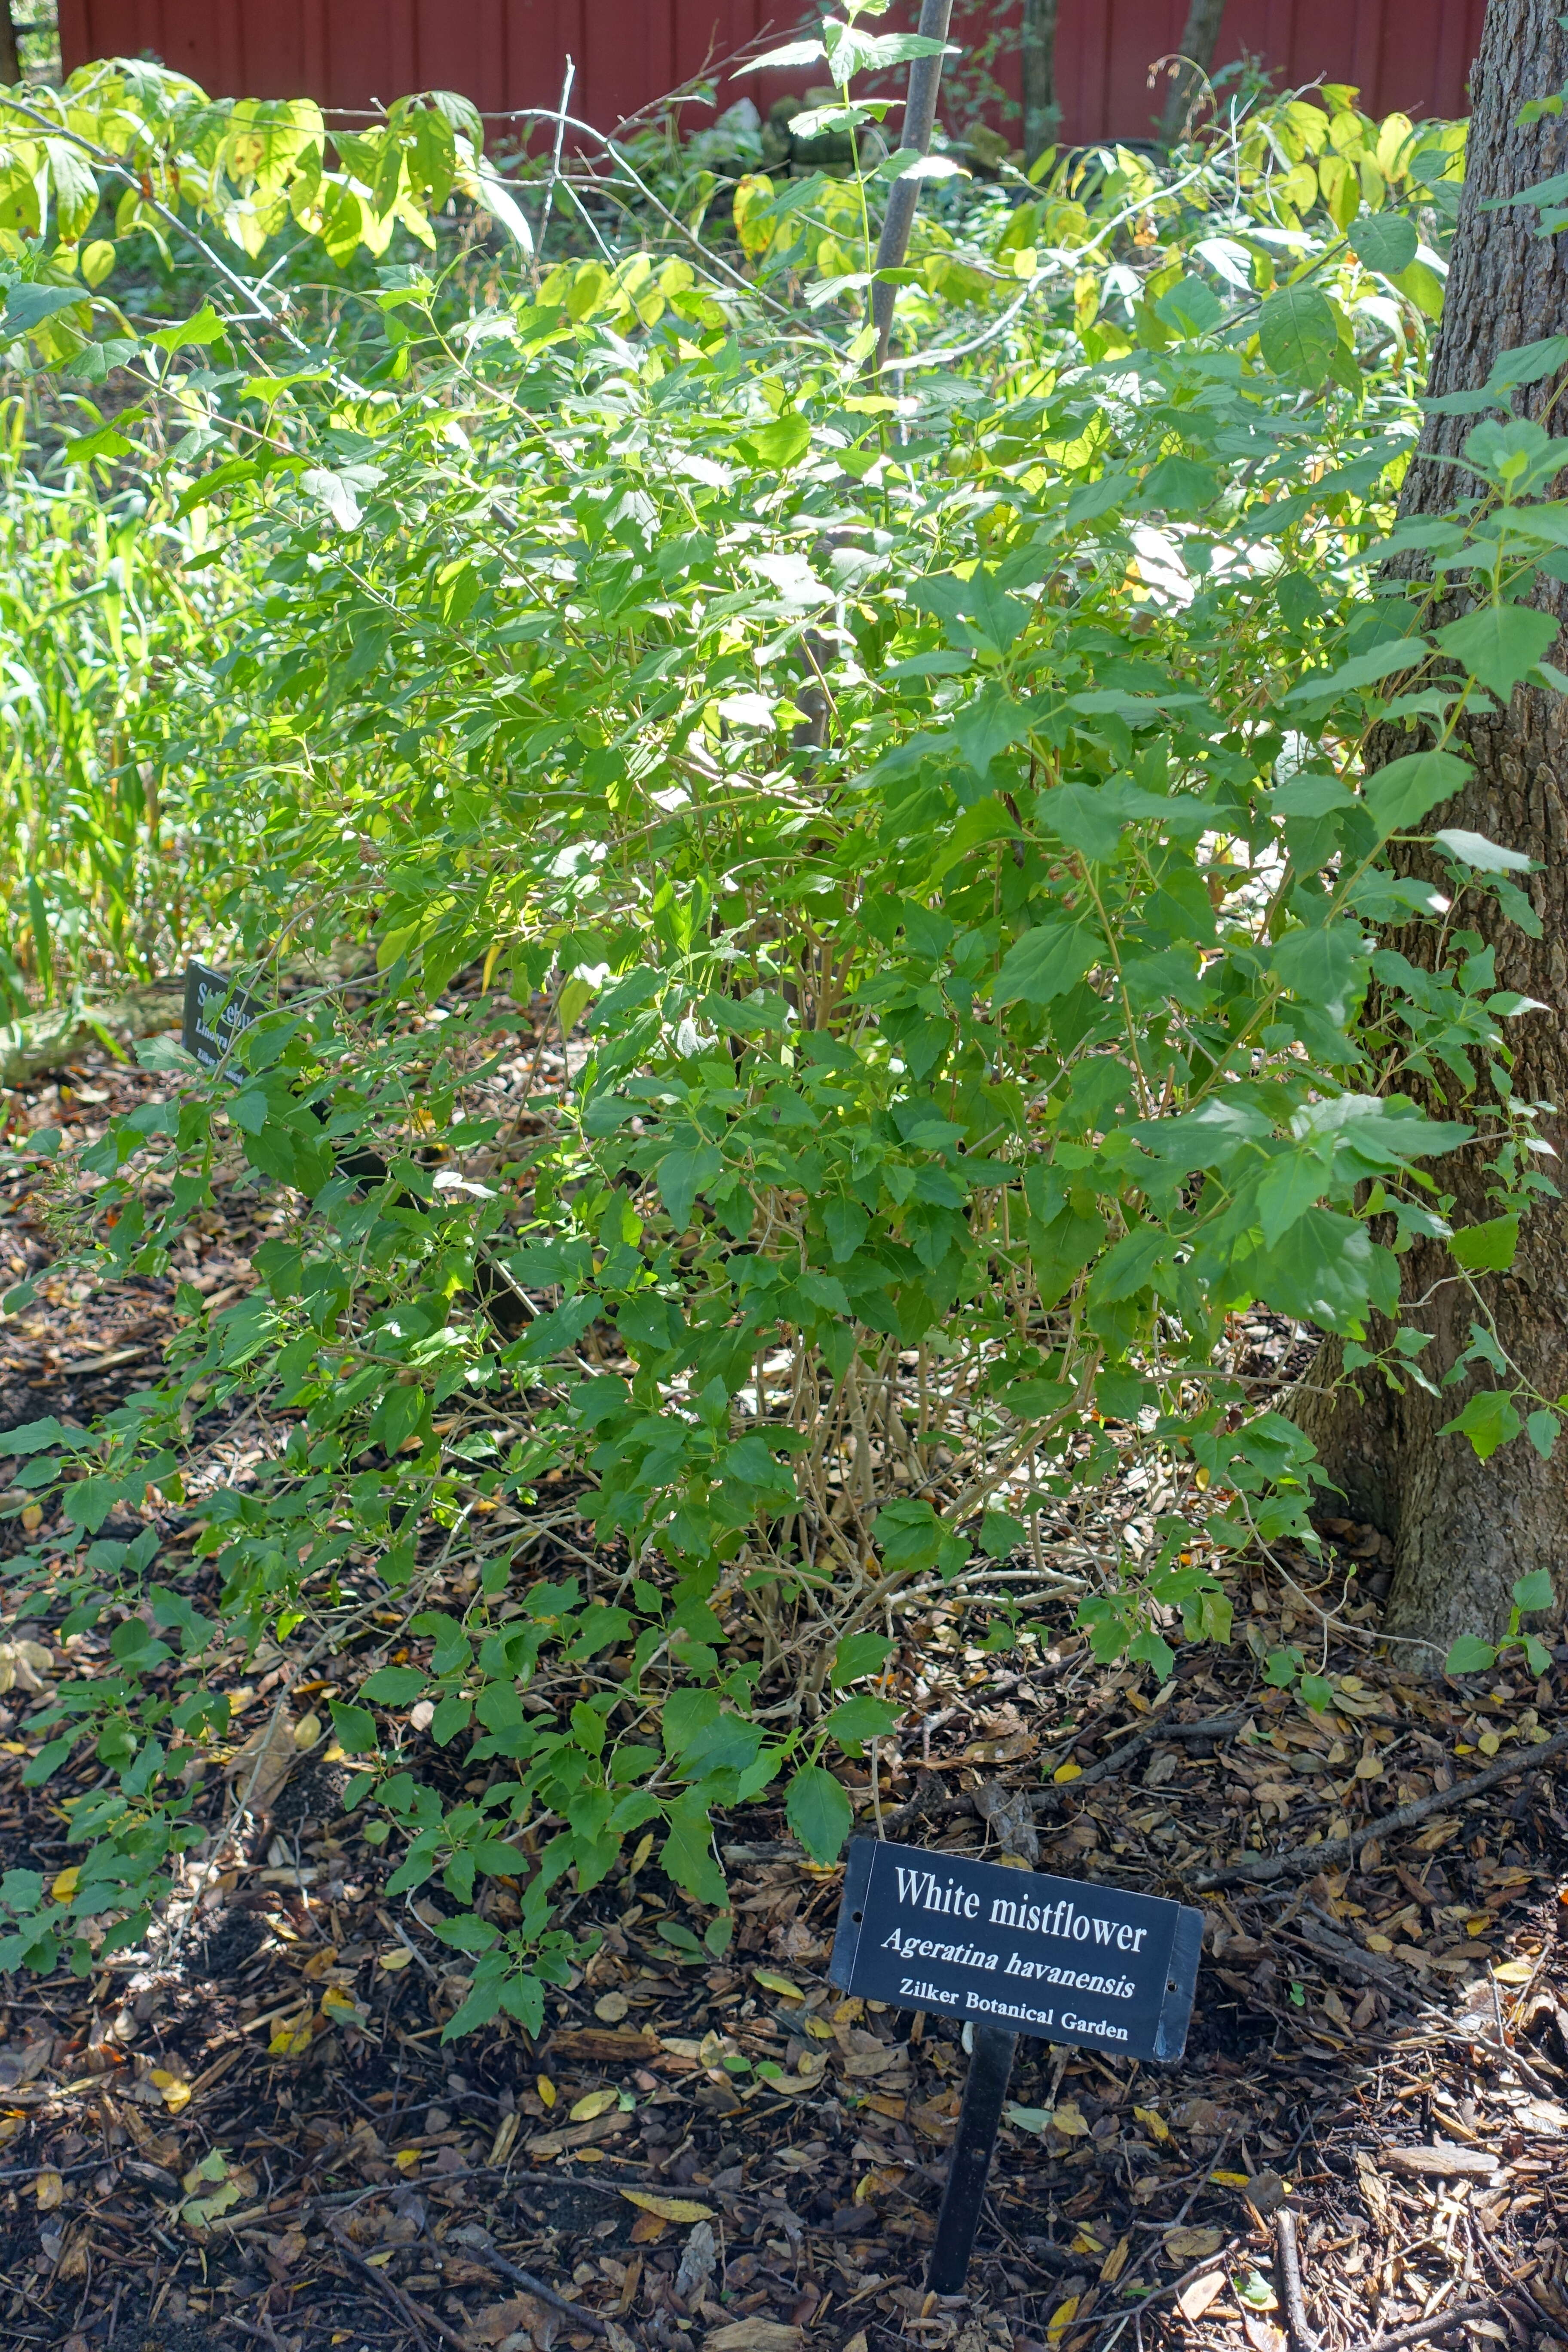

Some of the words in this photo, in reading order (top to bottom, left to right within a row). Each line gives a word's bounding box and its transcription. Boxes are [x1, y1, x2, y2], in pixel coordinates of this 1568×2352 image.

[895, 1867, 980, 1918] White
[988, 1893, 1148, 1953] mistflower
[880, 1928, 999, 1970] Ageratina
[1003, 1952, 1136, 1999] havanensis
[899, 1978, 960, 2005] Zilker
[965, 1991, 1054, 2025] Botanical
[1061, 2012, 1129, 2041] Garden
